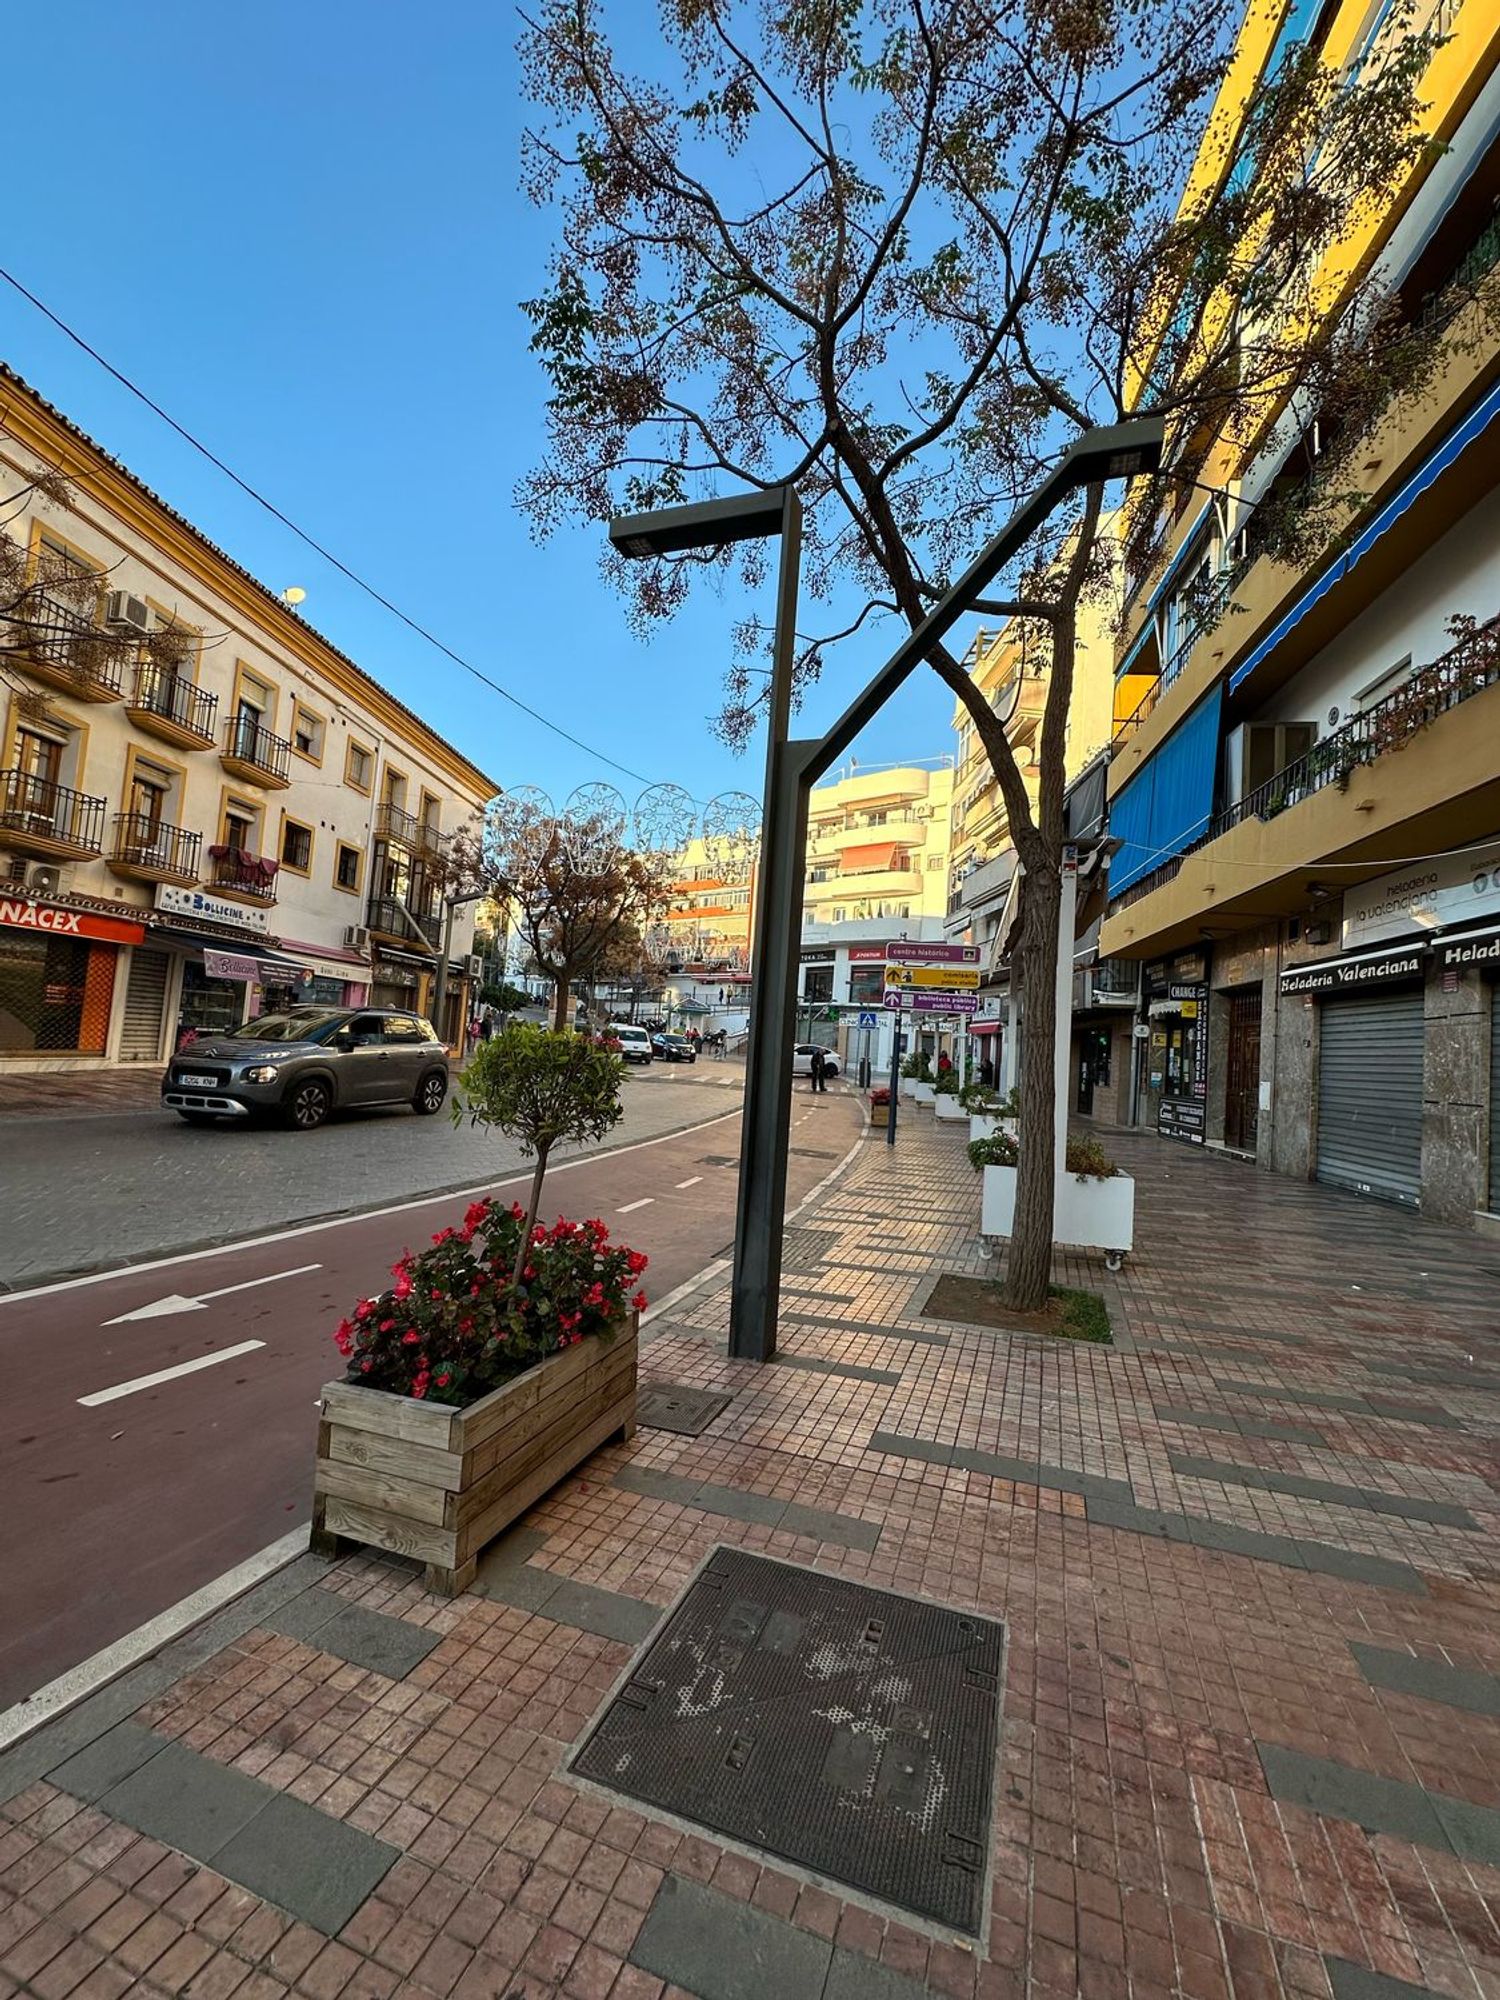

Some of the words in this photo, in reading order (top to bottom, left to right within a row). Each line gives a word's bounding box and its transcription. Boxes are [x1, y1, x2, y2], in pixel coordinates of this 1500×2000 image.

[0, 900, 82, 932] NACEX
[893, 948, 916, 956] centro
[1445, 938, 1500, 965] Helad
[1337, 957, 1419, 982] Valenciana
[1170, 986, 1196, 998] CHANGE
[918, 995, 950, 1003] biblioteca
[953, 1003, 976, 1012] library
